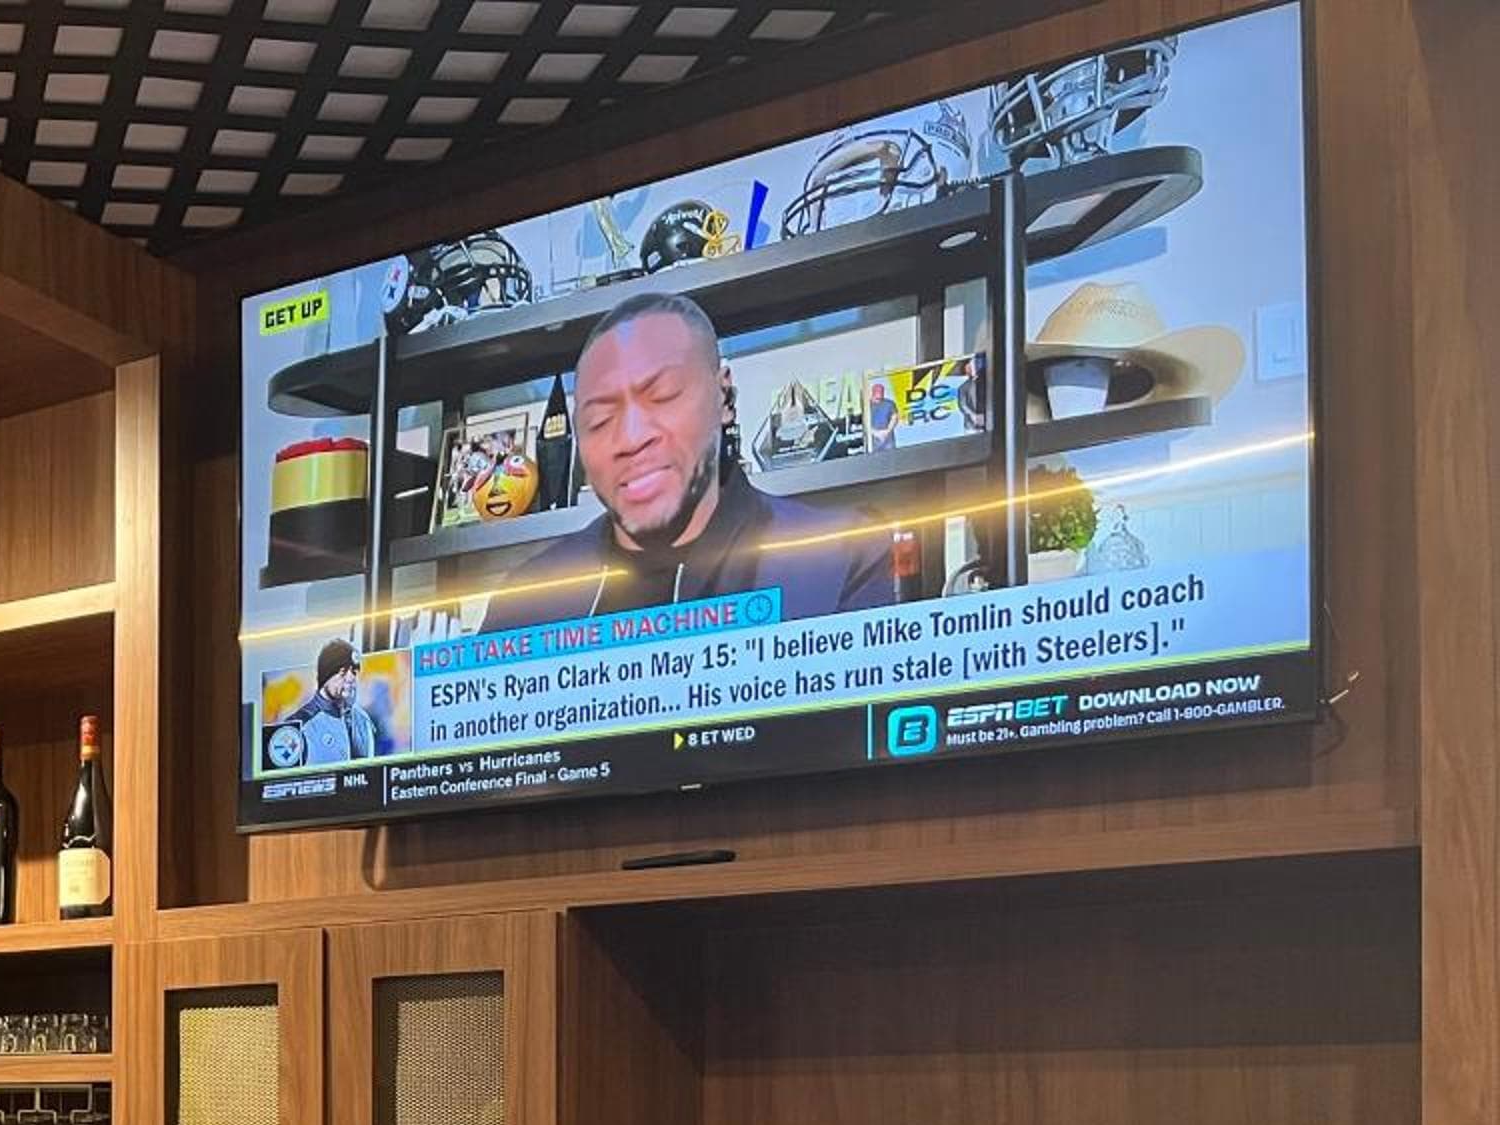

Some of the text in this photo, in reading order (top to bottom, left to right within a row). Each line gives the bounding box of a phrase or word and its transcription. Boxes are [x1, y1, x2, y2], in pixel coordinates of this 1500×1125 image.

[264, 297, 324, 329] GET UP
[419, 601, 738, 671] HOT TAKE TIME MACHINE
[430, 678, 497, 708] ESPN's
[504, 673, 550, 702] Ryan
[557, 661, 610, 690] Clark
[617, 659, 643, 683] on
[650, 651, 694, 679] May
[701, 644, 738, 671] 15:
[773, 629, 854, 660] believe
[863, 617, 922, 648] Mike
[929, 603, 1012, 638] Tomlin
[1021, 586, 1110, 626] should
[1121, 573, 1205, 612] coach
[430, 719, 447, 742] in
[453, 709, 528, 740] another
[535, 693, 682, 732] organization...
[688, 682, 722, 709] His
[729, 676, 787, 703] voice
[794, 669, 836, 696] has
[844, 664, 884, 690] run
[891, 651, 953, 684] stale
[962, 640, 1027, 681] [with
[1079, 681, 1201, 711] DOWNLOAD
[1205, 674, 1262, 696] NOW
[687, 725, 756, 747] 8 ET WED
[945, 730, 977, 746] Must
[979, 728, 994, 743] be
[1019, 717, 1081, 738] Gambling
[1083, 709, 1145, 734] problem?
[1146, 706, 1172, 723] Call
[1173, 696, 1286, 721] 1-800-GAMBLER.
[343, 773, 370, 788] NHL
[390, 750, 562, 782] Panthers vs Hurricanes
[390, 782, 439, 802] Eastern
[440, 774, 513, 797] Conference
[515, 769, 547, 789] Final
[557, 765, 598, 783] Game
[598, 762, 612, 778] 5
